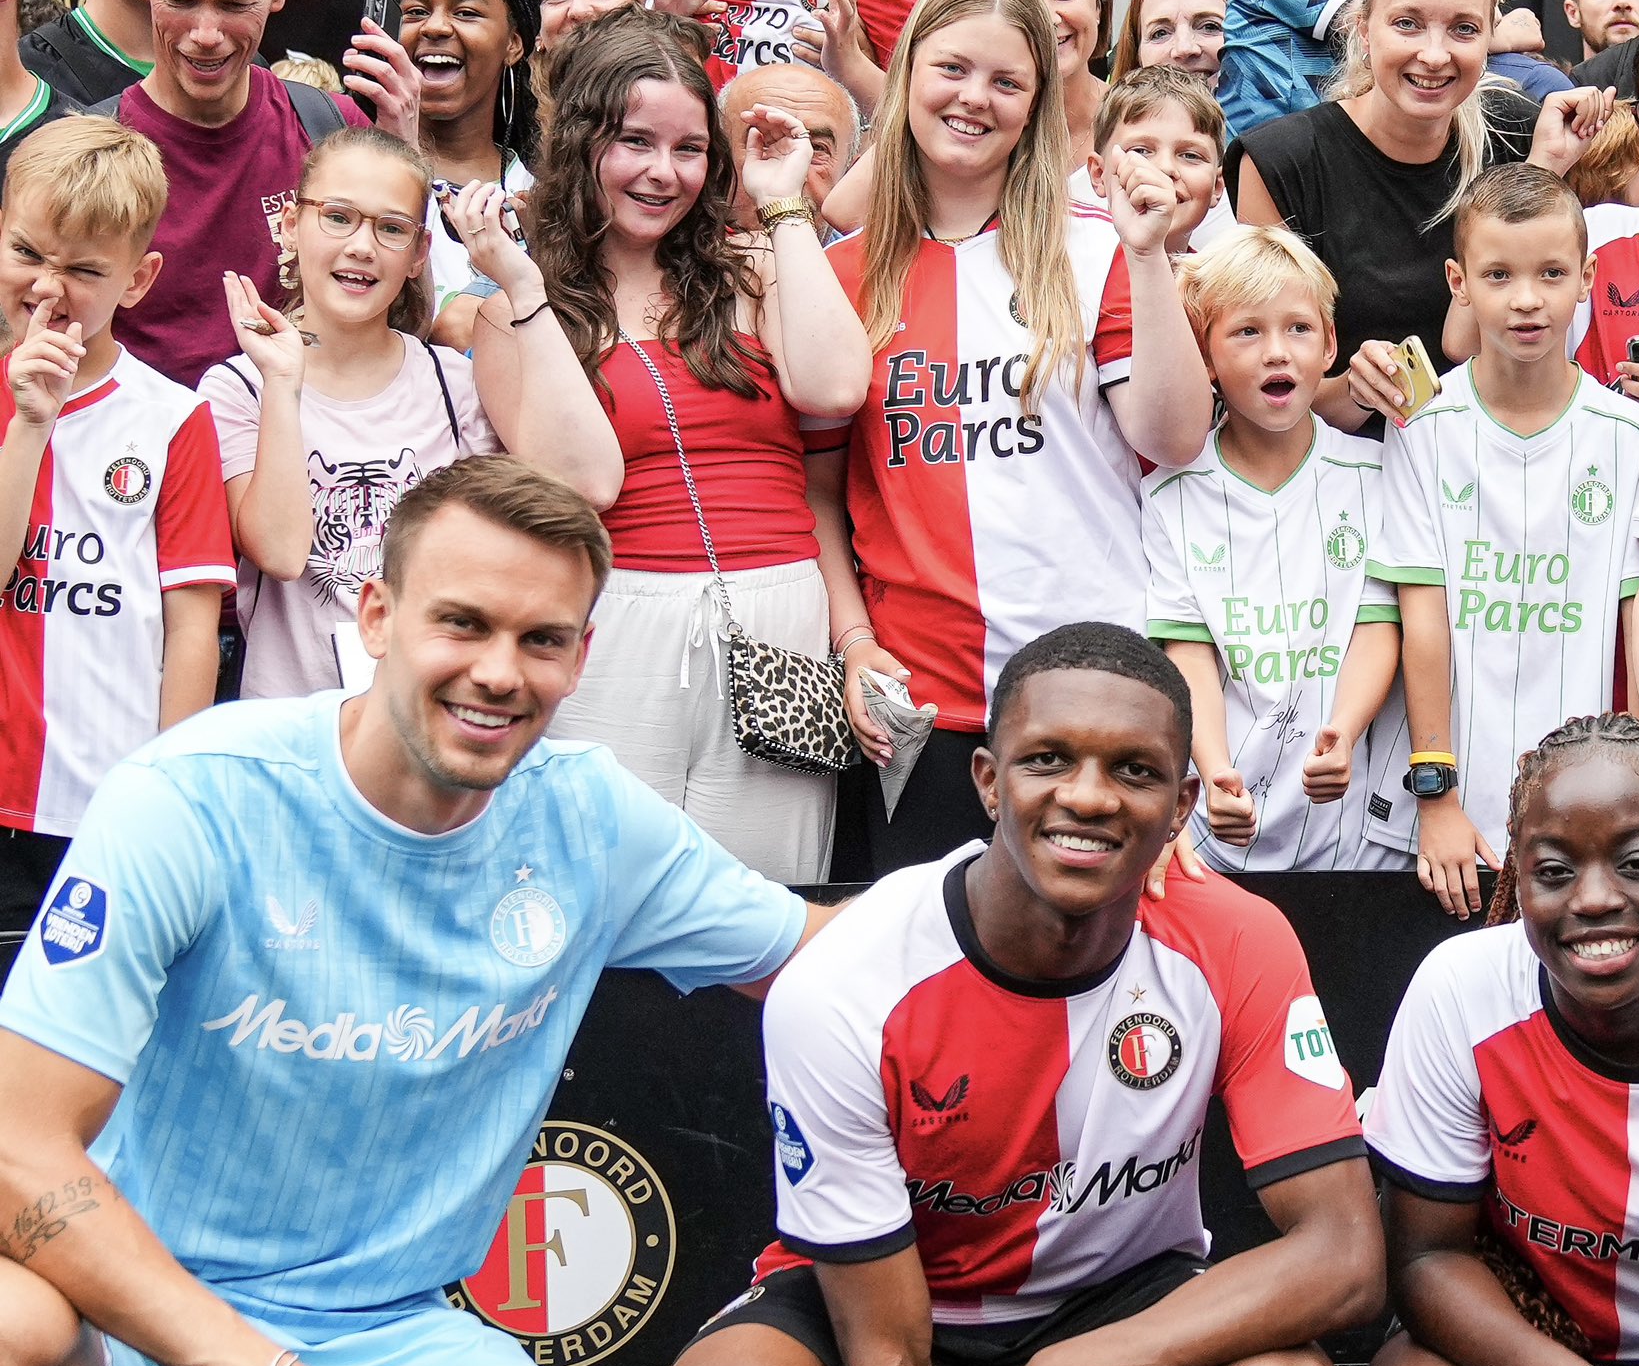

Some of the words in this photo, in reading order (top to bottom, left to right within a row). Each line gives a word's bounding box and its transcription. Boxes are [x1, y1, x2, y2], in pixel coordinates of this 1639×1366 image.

[884, 413, 1046, 468] Parcs
[24, 524, 106, 565] uro
[1460, 539, 1570, 585] Euro
[1221, 597, 1329, 637] Euro
[1454, 587, 1583, 633] Parcs
[1224, 643, 1341, 684] Parcs
[203, 994, 385, 1061] Media
[1109, 1014, 1178, 1046] FEYENOORD
[1290, 1026, 1334, 1062] TOT
[1112, 1055, 1182, 1090] ROTTERDAM
